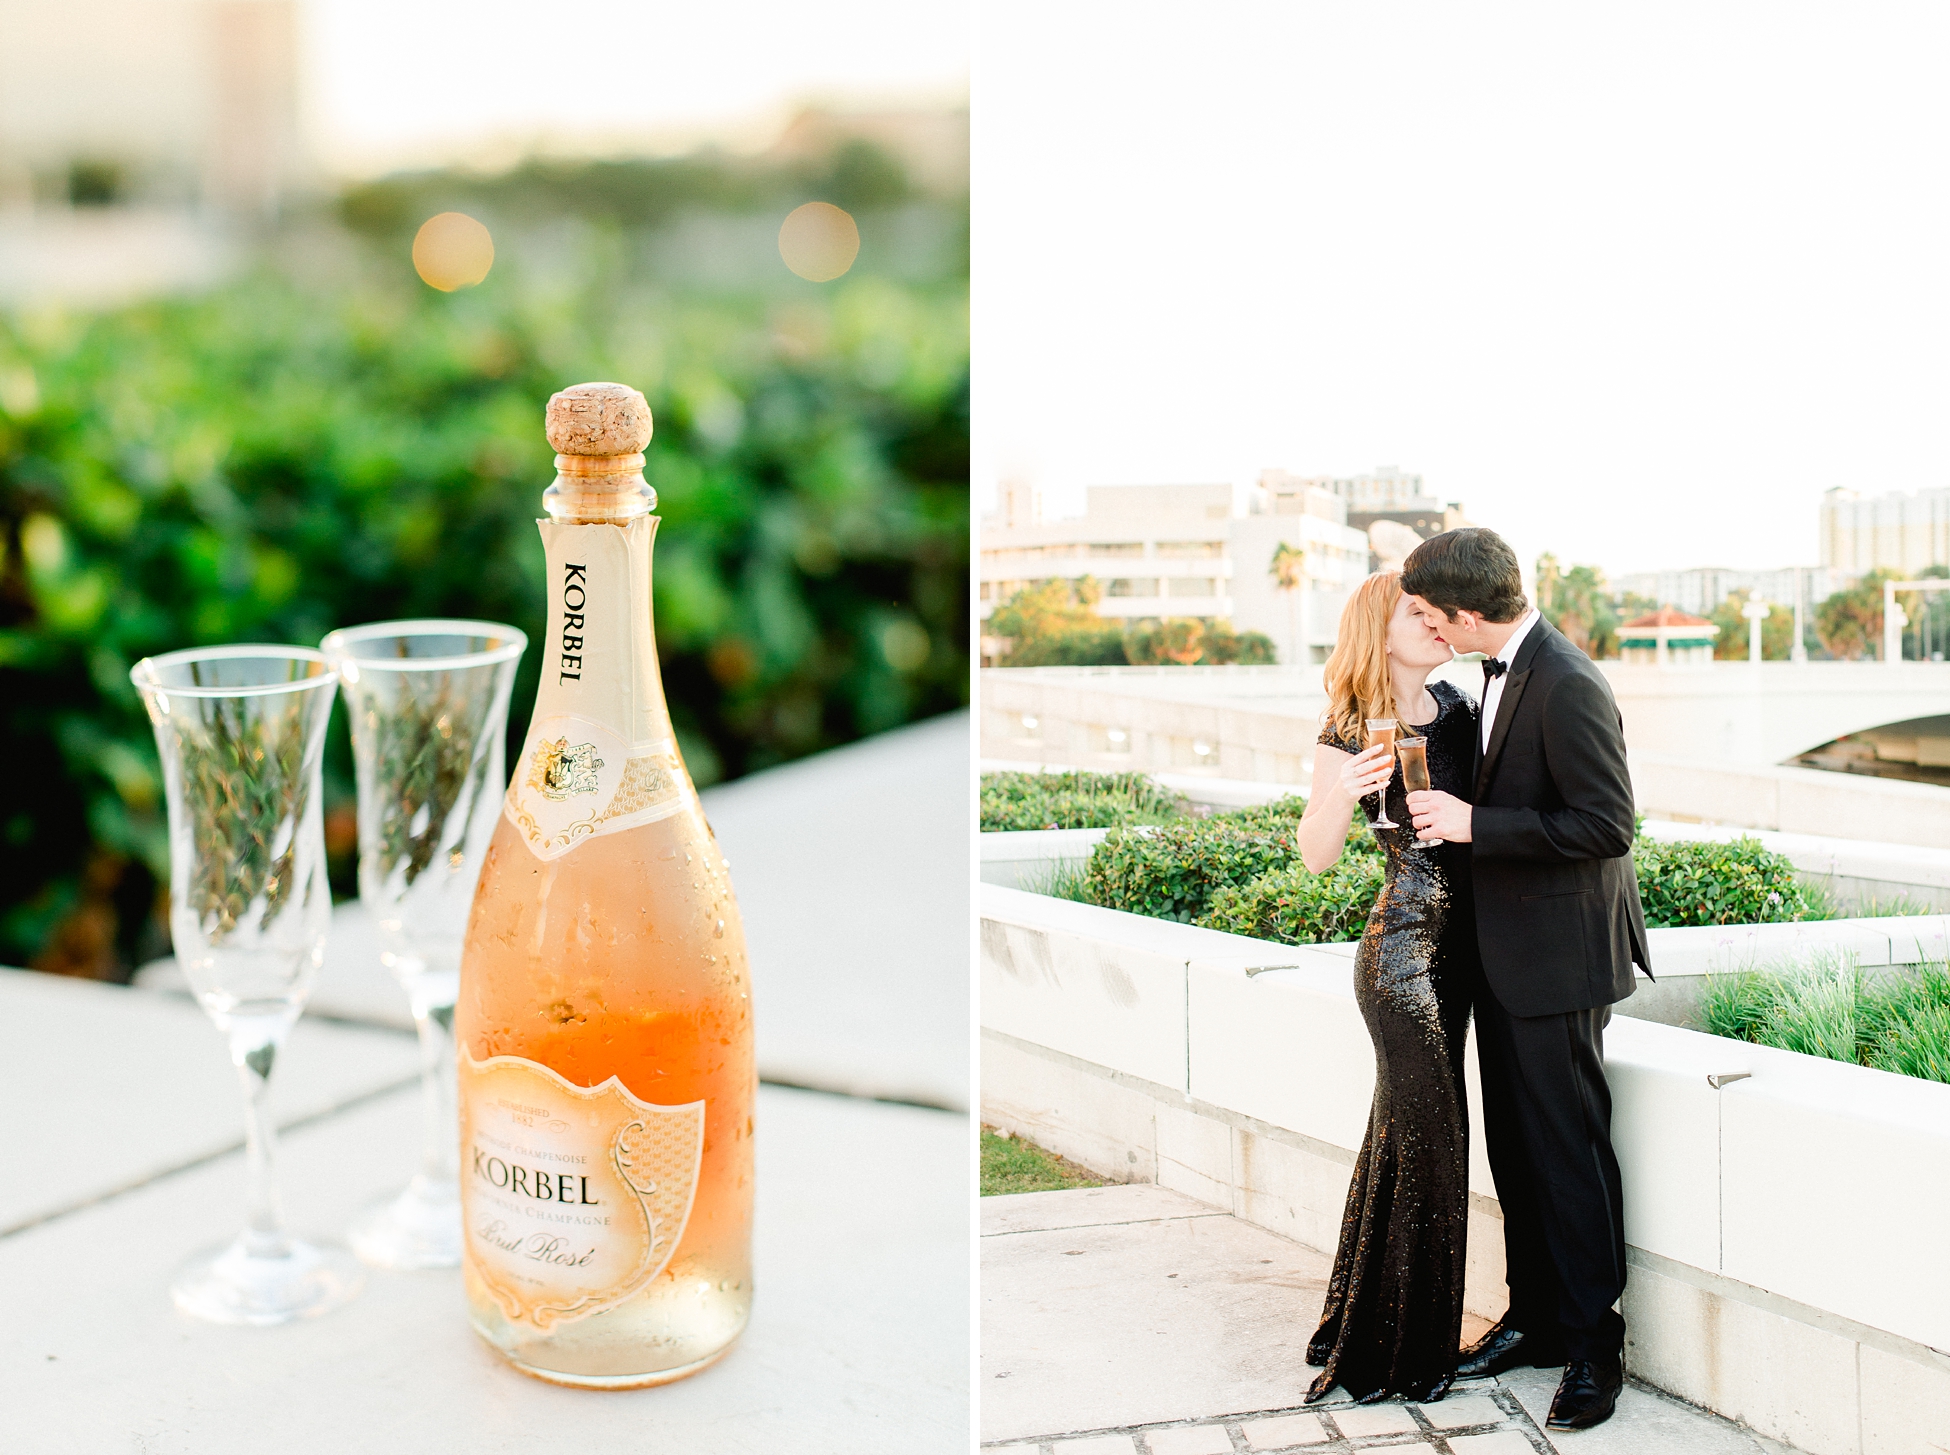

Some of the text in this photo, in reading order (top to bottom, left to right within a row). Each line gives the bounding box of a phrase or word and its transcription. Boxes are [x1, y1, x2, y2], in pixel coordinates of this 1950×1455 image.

[559, 562, 587, 686] KORBEL
[514, 1145, 588, 1164] CHAMPENOISE
[473, 1145, 599, 1205] KORBEL
[525, 1206, 612, 1226] CHAMPAGNE
[523, 1232, 596, 1268] Rosé
